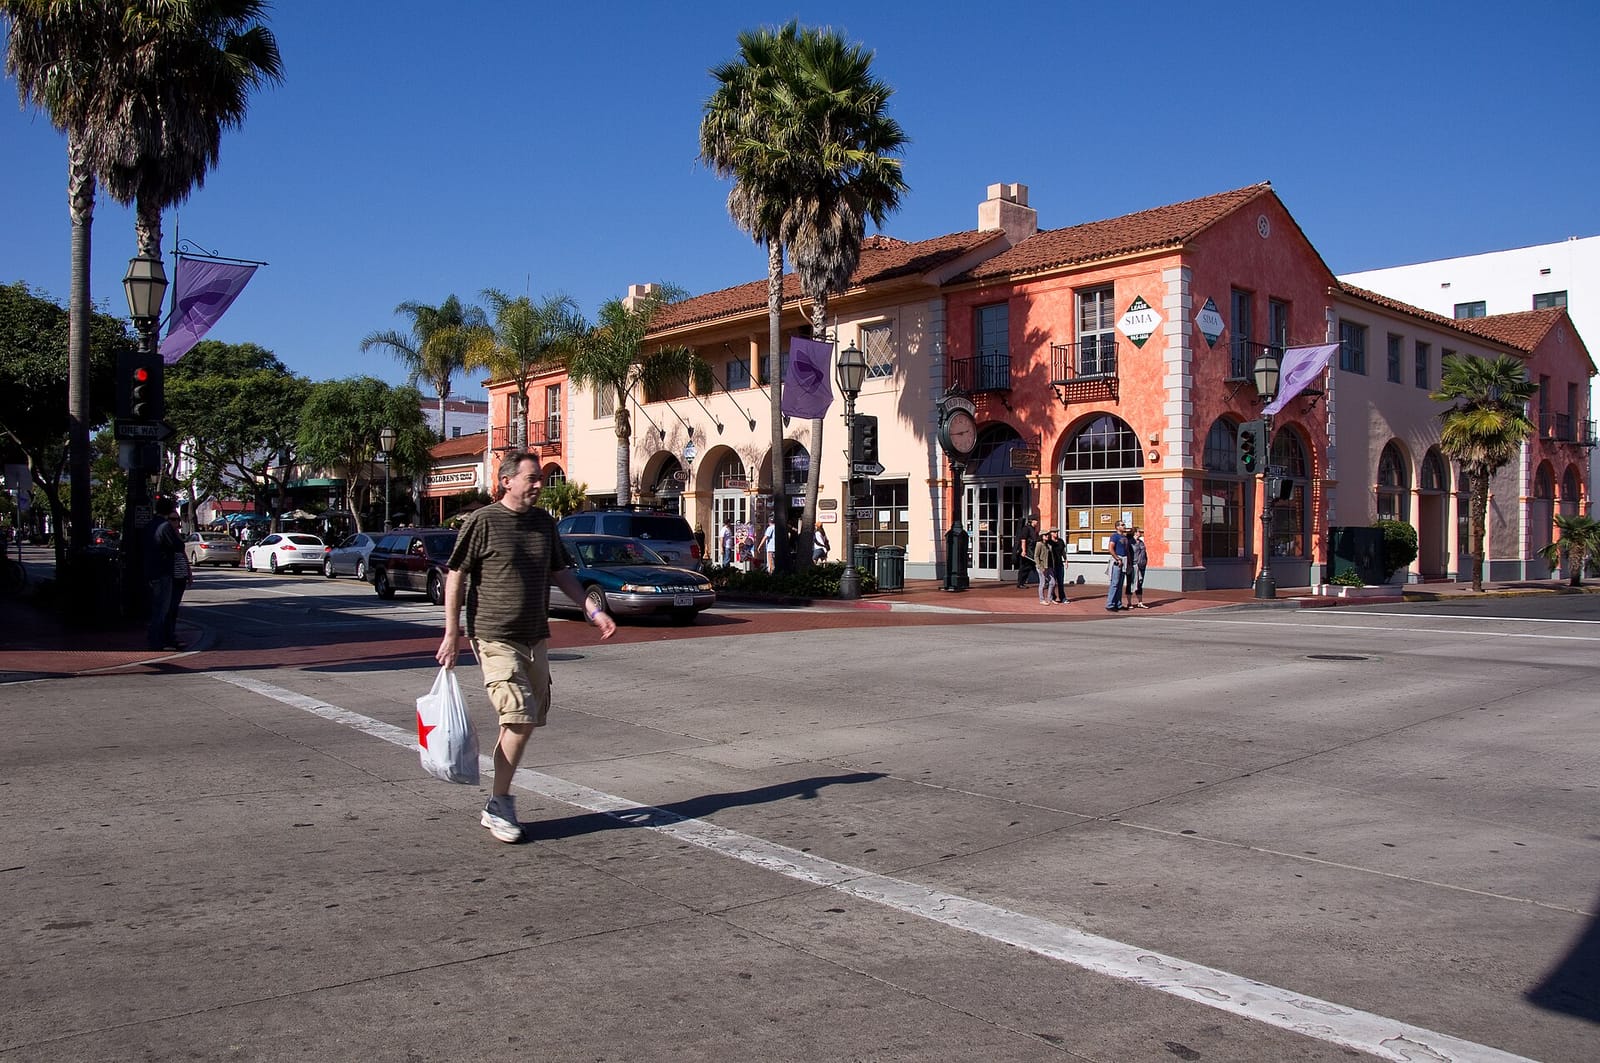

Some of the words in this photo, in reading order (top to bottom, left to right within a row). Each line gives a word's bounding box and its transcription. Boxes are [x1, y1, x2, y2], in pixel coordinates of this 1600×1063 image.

[1131, 303, 1147, 311] LEASE
[1125, 313, 1153, 326] SIMA
[1203, 314, 1218, 326] SIMA
[120, 426, 139, 435] ONE
[141, 427, 160, 435] WAY
